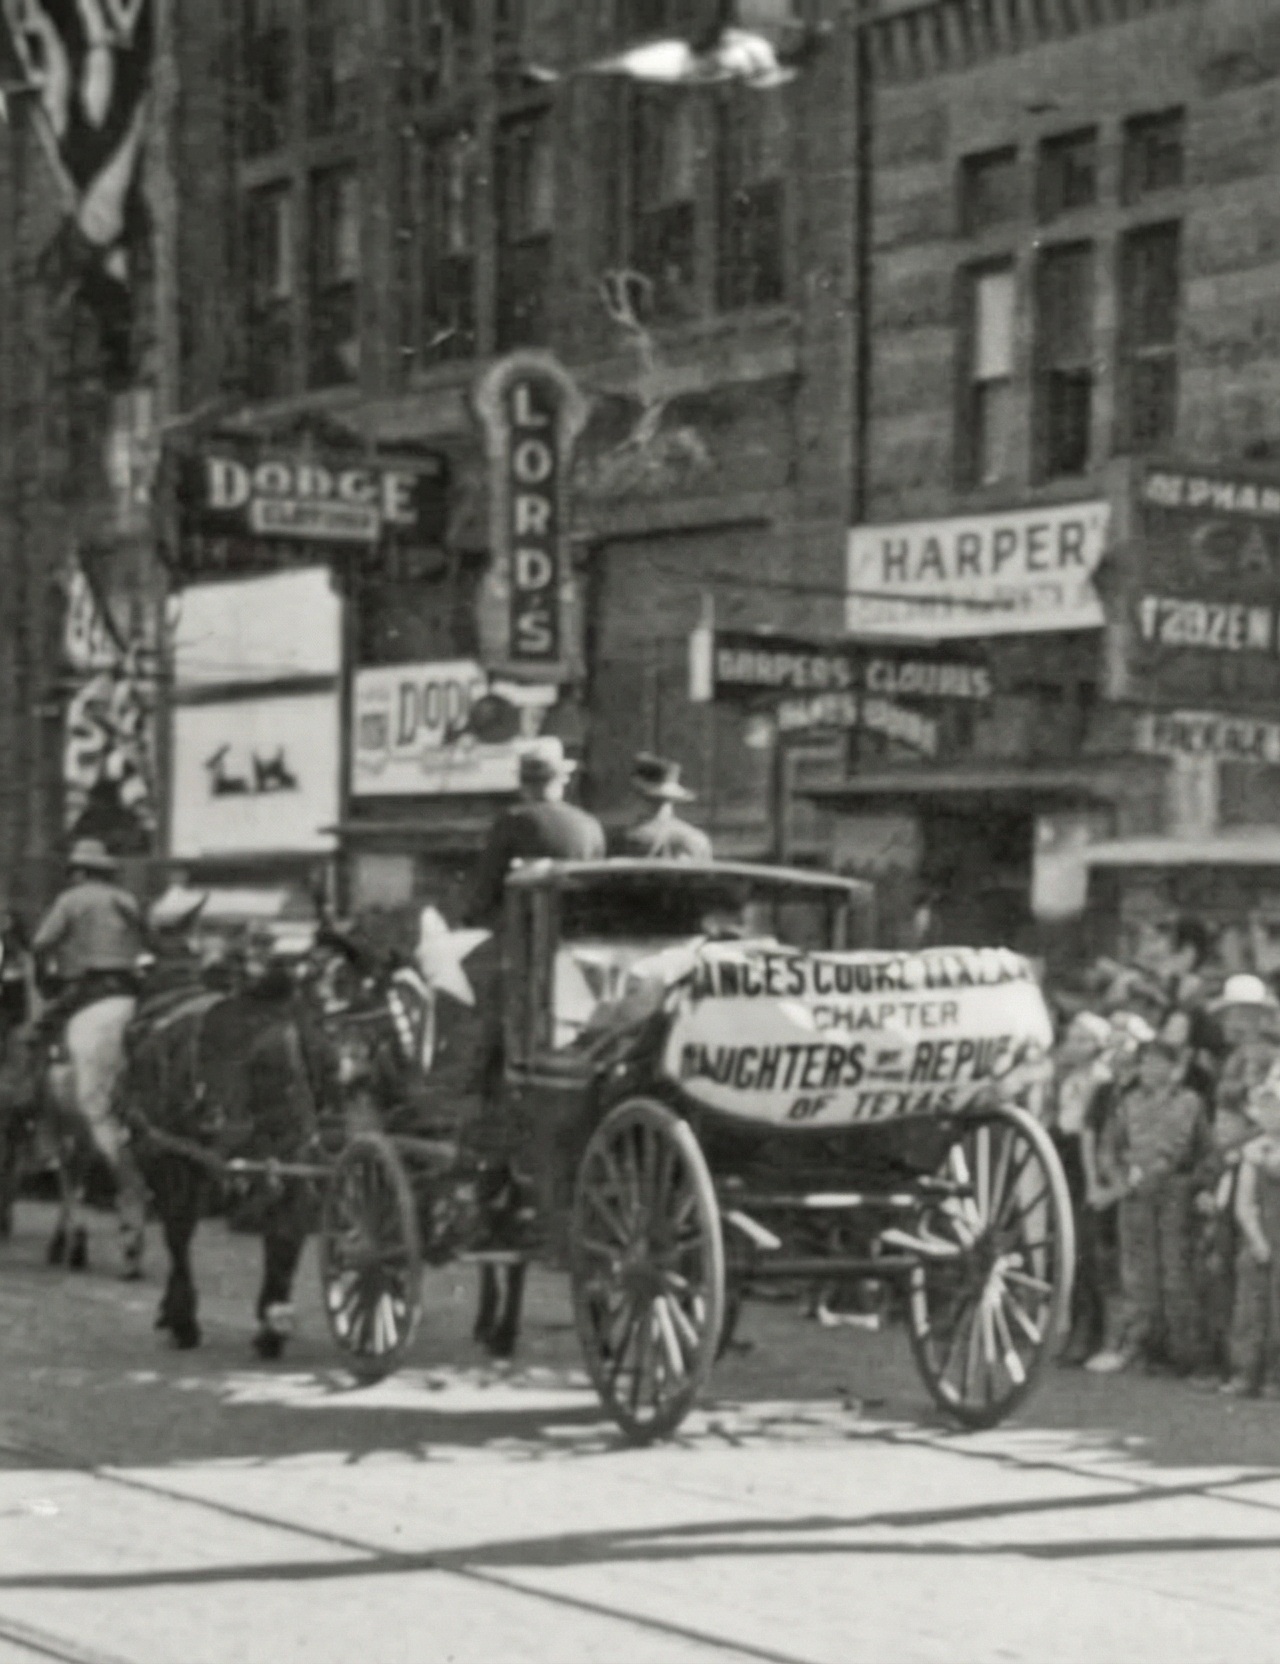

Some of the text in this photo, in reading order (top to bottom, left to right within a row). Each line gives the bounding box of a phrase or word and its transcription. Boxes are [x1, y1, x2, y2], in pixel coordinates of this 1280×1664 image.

[206, 456, 418, 524] DODGE
[397, 682, 483, 746] DOD
[813, 1001, 958, 1031] CHAPTER
[787, 1094, 830, 1120] OF
